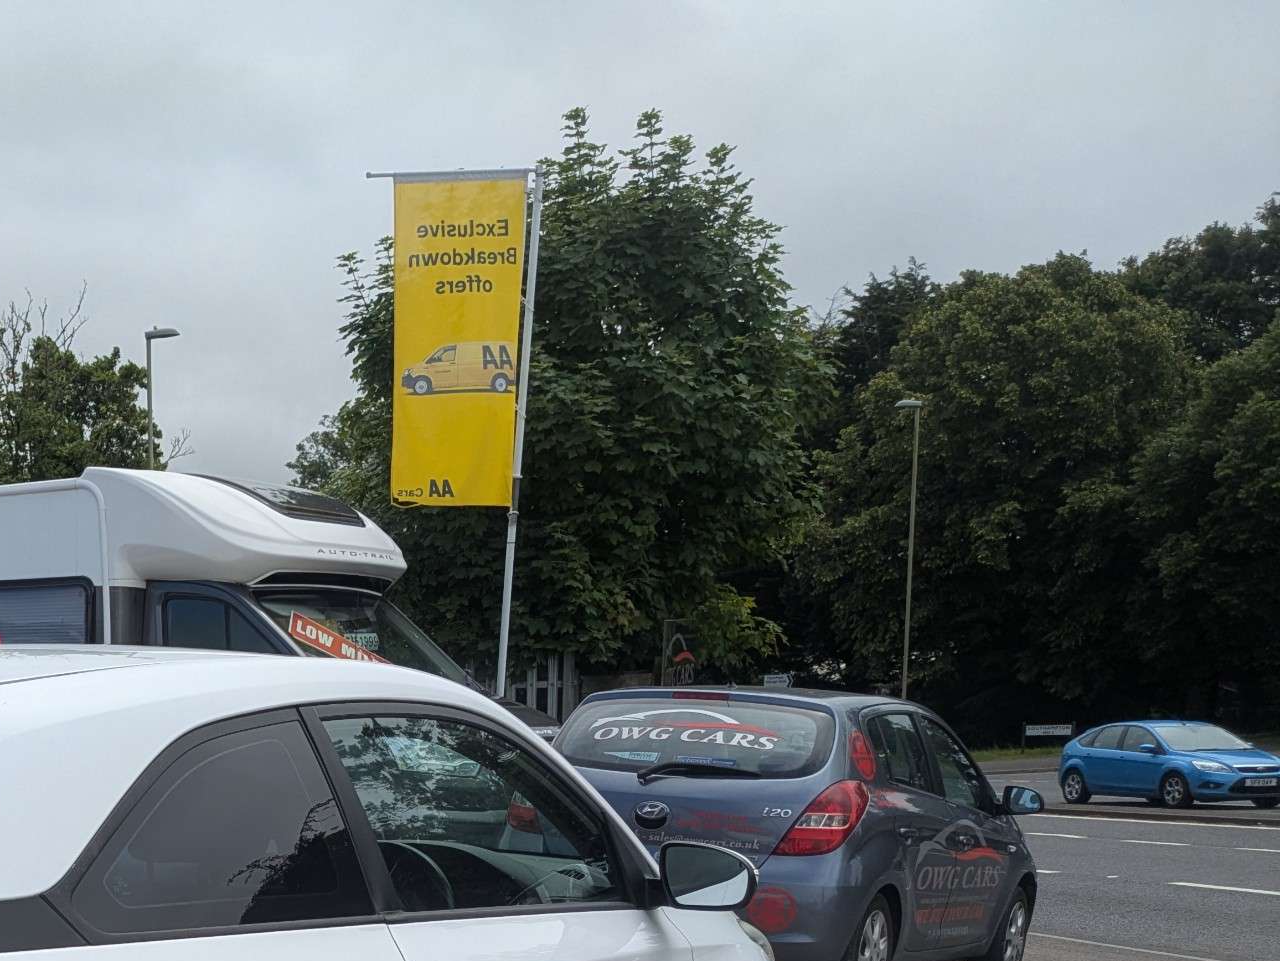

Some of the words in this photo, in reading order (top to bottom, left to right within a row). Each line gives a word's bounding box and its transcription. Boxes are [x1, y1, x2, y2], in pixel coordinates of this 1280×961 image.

[296, 620, 335, 648] LOW
[593, 727, 674, 740] OWG
[680, 729, 779, 750] CARS
[916, 866, 961, 890] OWG
[962, 865, 1001, 889] CARS
